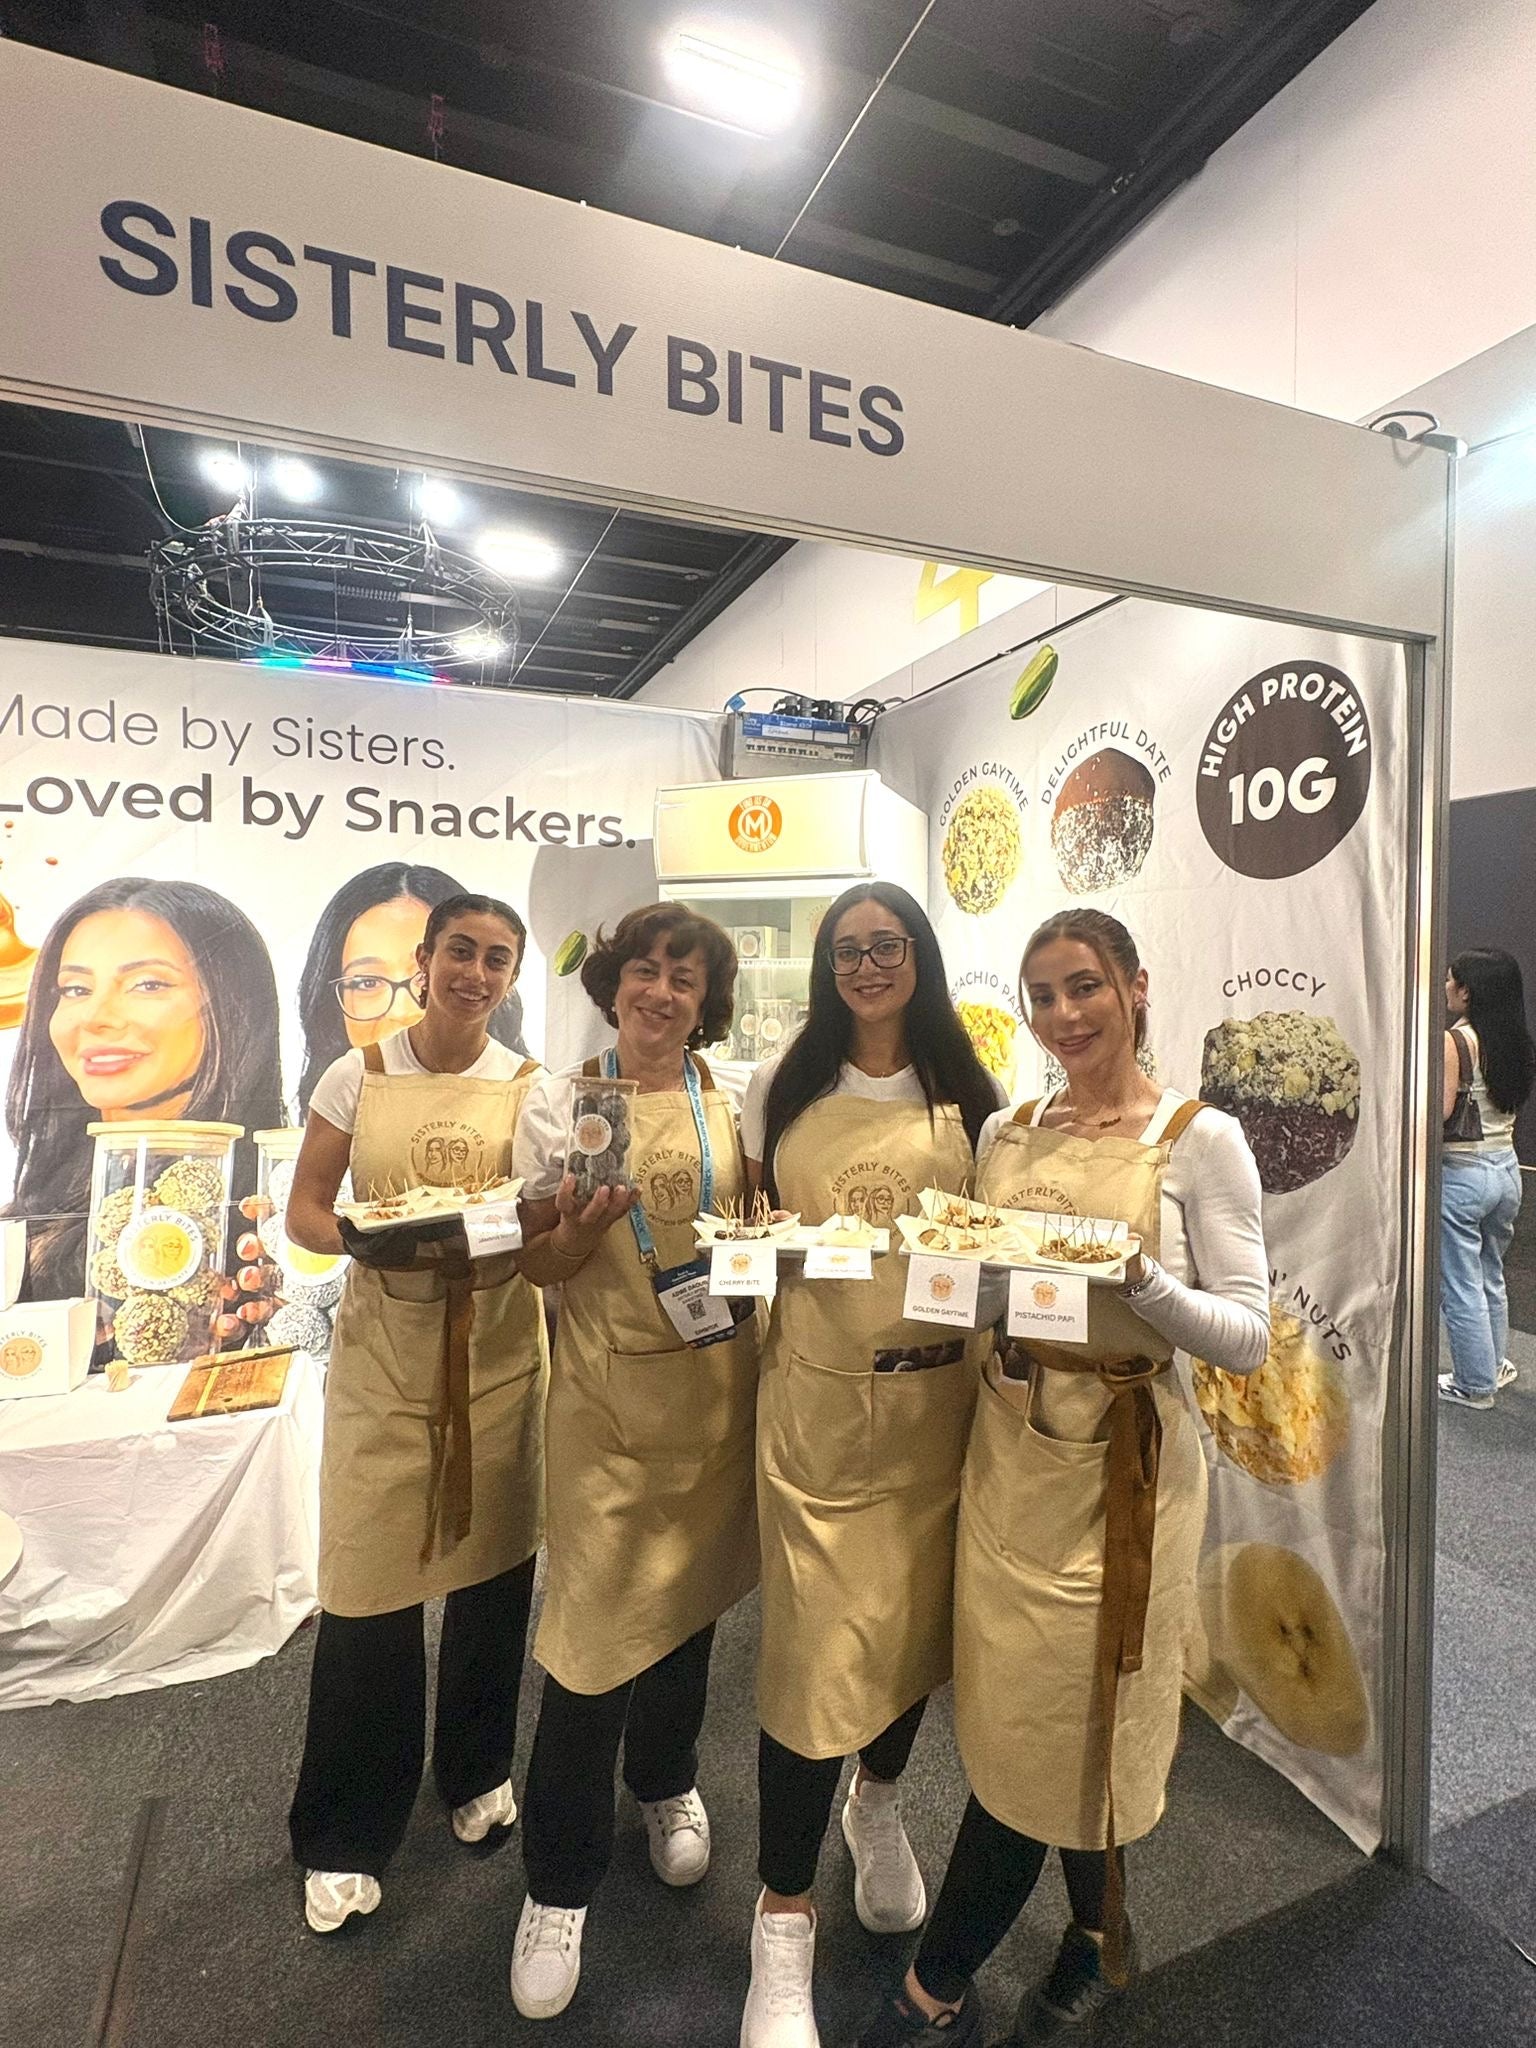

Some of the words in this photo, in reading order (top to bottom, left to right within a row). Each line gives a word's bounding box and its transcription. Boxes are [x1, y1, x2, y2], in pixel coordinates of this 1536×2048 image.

[99, 200, 637, 396] SISTERLY
[667, 335, 904, 457] BITES
[181, 706, 253, 766] by
[272, 715, 457, 771] Sisters.
[1201, 693, 1256, 778] HIGH
[1261, 672, 1368, 758] PROTEIN
[939, 764, 978, 827] GOLDEN
[981, 761, 1030, 813] GAYTIME
[1041, 721, 1130, 805] DELIGHTFUL
[1135, 729, 1172, 784] DATE
[1228, 756, 1338, 826] 10G
[242, 776, 325, 841] by
[344, 785, 638, 850] Snackers.
[951, 971, 999, 1001] STACHIO
[1222, 968, 1327, 998] CHOCCY
[410, 1120, 457, 1144] SISTERLY
[460, 1122, 485, 1147] BITES
[634, 1149, 674, 1185] SISTERLY
[831, 1162, 879, 1194] SISTERLY
[882, 1165, 911, 1193] BITES
[912, 1305, 940, 1314] GOLDEN
[941, 1308, 970, 1318] GAYTIME
[1014, 1311, 1056, 1322] PISTACHIO
[1057, 1315, 1076, 1323] PAPI
[1293, 1285, 1352, 1361] NUTS
